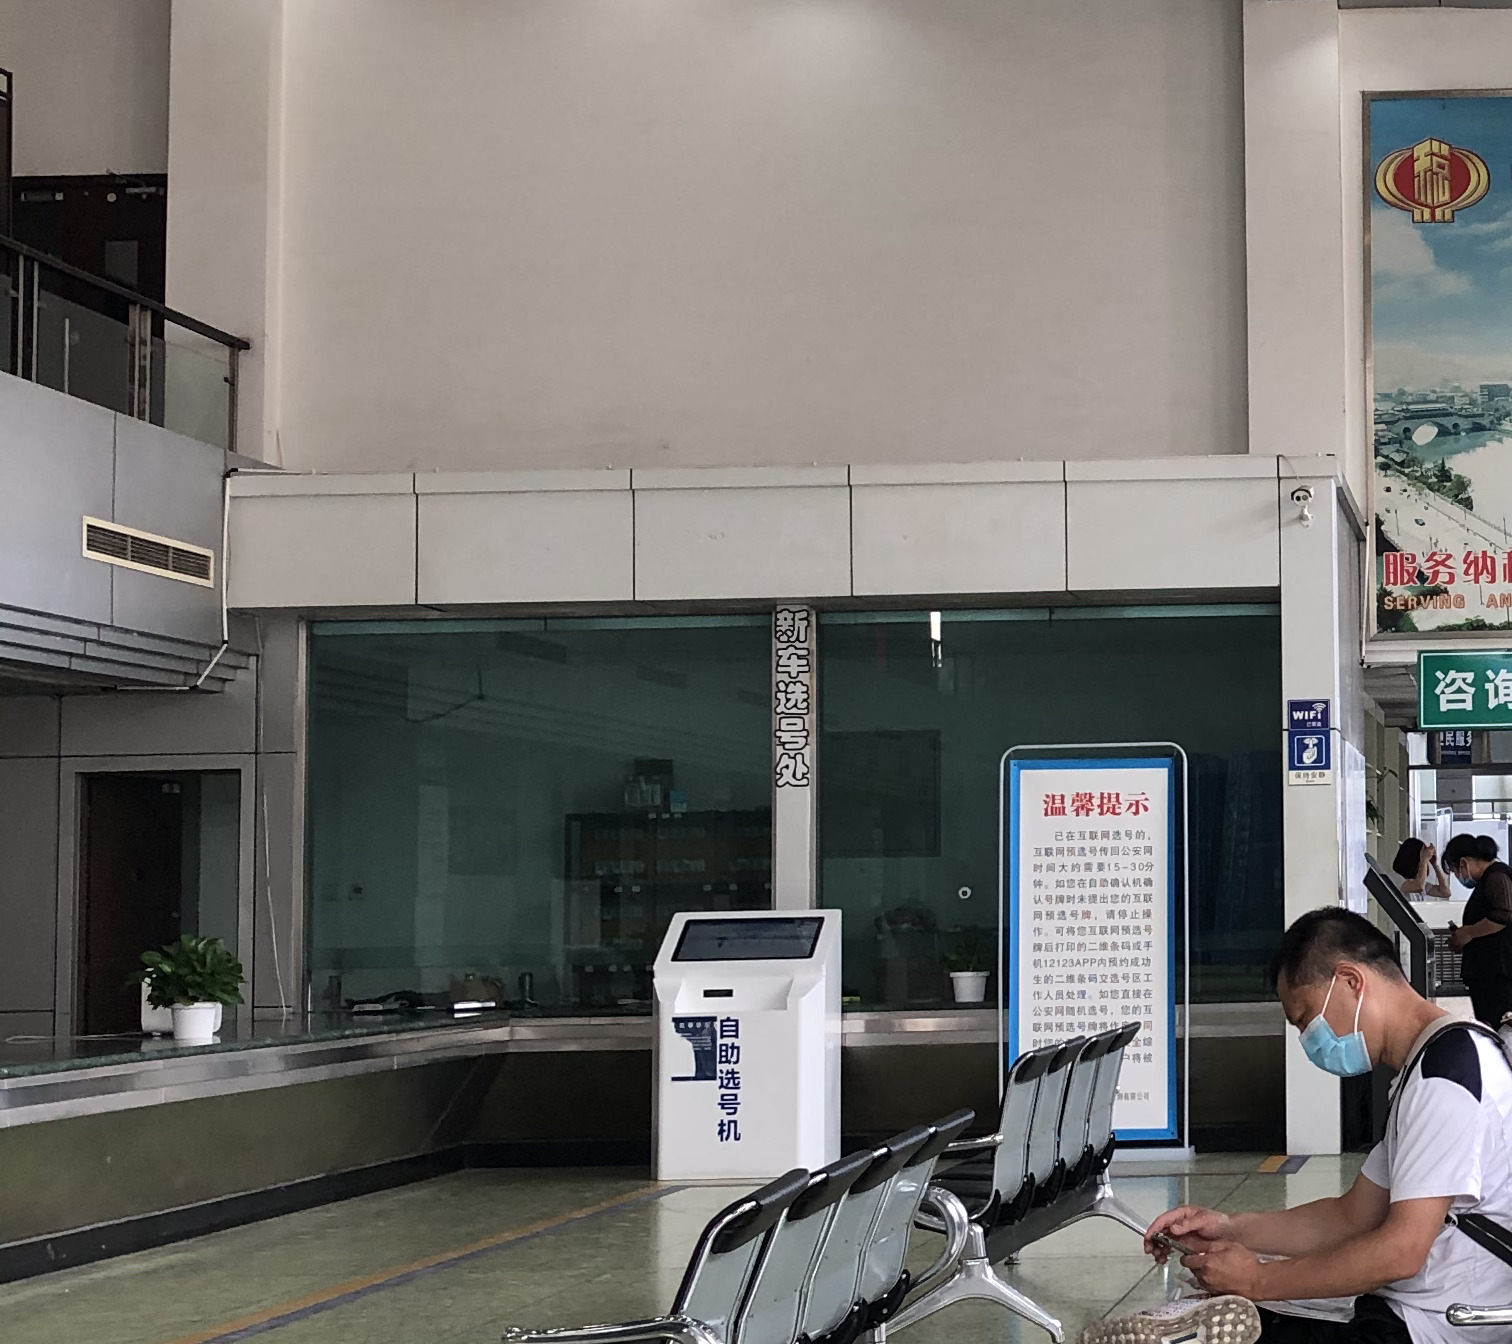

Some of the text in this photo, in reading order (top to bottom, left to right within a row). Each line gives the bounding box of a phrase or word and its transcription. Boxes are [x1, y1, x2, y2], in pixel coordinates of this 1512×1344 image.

[1384, 593, 1466, 610] SERVING
[775, 608, 811, 788] 新车选号处
[1043, 792, 1150, 817] 温馨提示
[717, 1017, 741, 1142] 自助选号机
